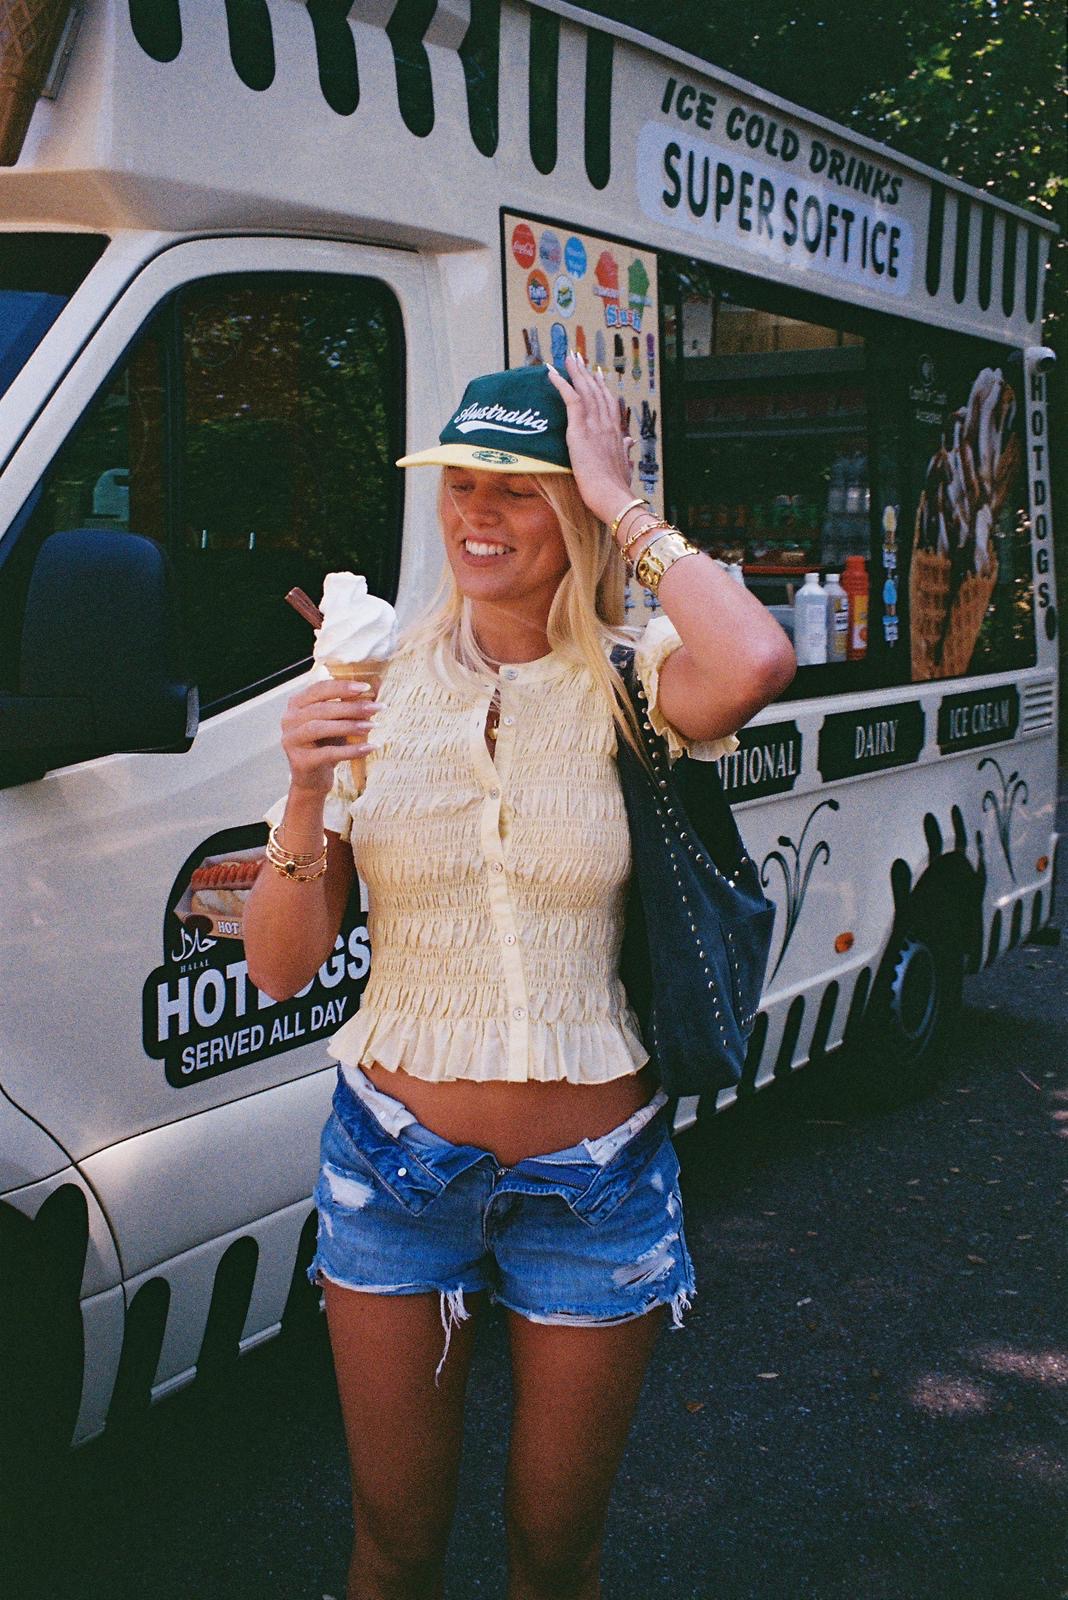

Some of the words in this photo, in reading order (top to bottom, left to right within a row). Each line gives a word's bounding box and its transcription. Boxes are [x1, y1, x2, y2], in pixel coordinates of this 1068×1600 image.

[661, 77, 717, 131] ICE
[726, 106, 800, 162] COLD
[809, 140, 903, 206] DRINKS
[861, 215, 900, 278] ICE
[453, 401, 549, 431] Australia
[717, 740, 797, 791] ITIONAL
[855, 719, 899, 760] DAIRY
[950, 706, 969, 740] ICE
[972, 699, 1010, 735] CREAM
[171, 927, 218, 962] حلال
[217, 921, 240, 935] HOT
[157, 926, 371, 1042] HOTGS
[180, 959, 210, 974] HALAL
[180, 1024, 265, 1075] SERVED
[269, 1012, 306, 1046] ALL
[310, 996, 348, 1031] DAY
